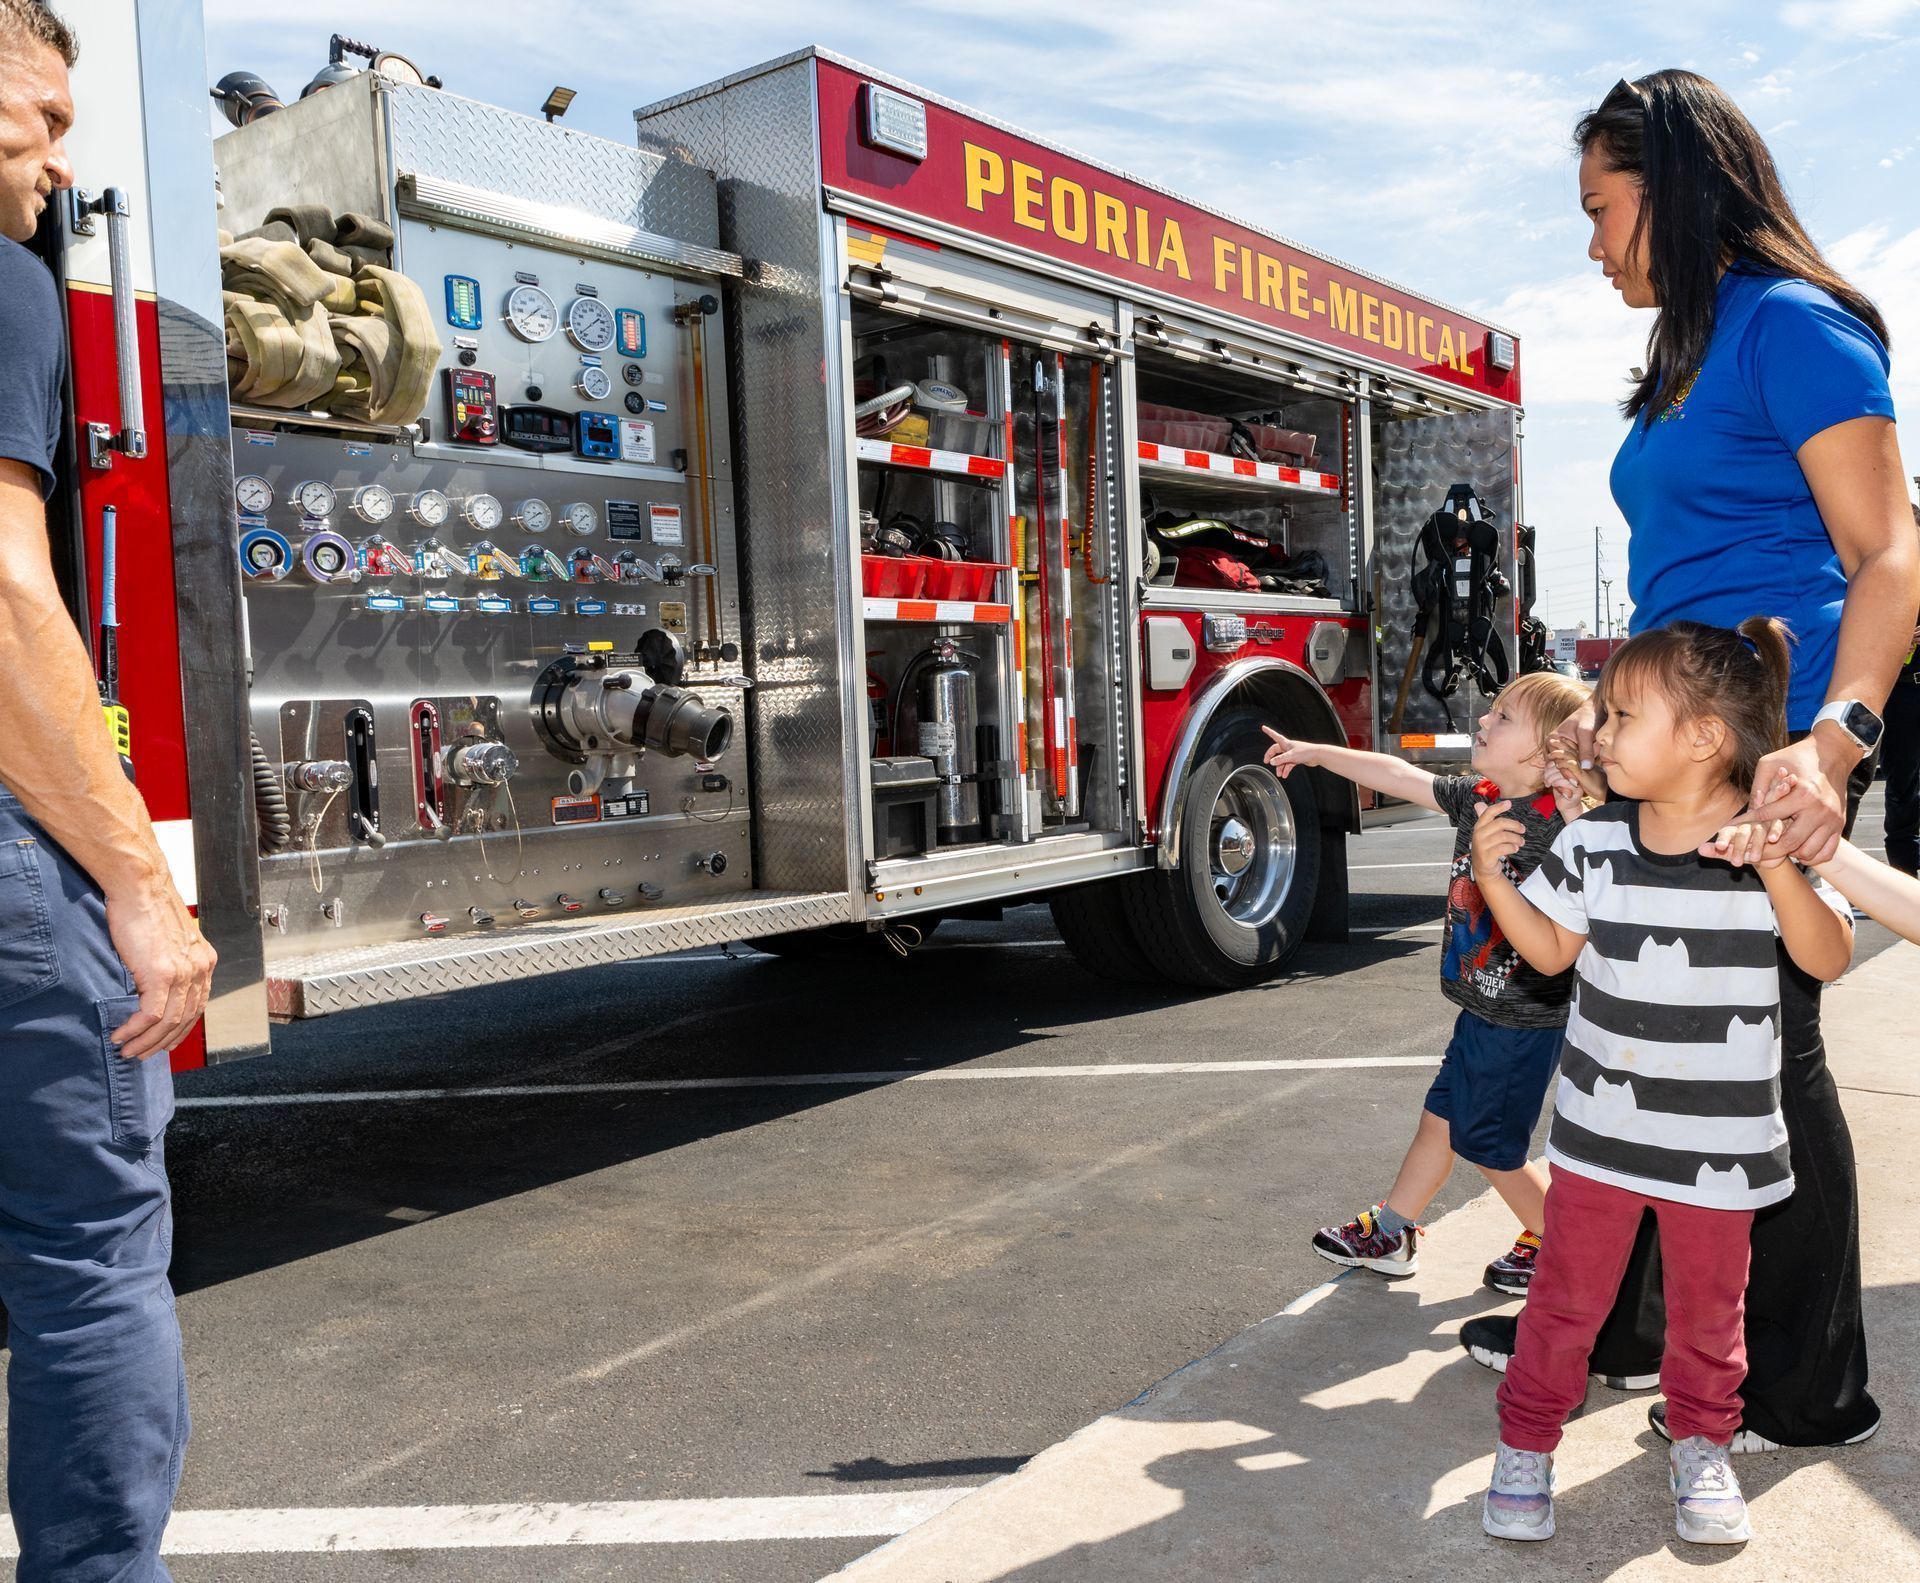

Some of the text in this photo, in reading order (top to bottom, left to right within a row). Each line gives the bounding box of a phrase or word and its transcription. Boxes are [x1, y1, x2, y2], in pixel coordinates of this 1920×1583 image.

[963, 141, 1476, 377] PEORIA FIRE-MEDICAL
[1246, 628, 1285, 638] osenbauer
[358, 709, 373, 722] OPEN
[423, 703, 437, 715] OPEN
[1475, 969, 1505, 990] SPIDER
